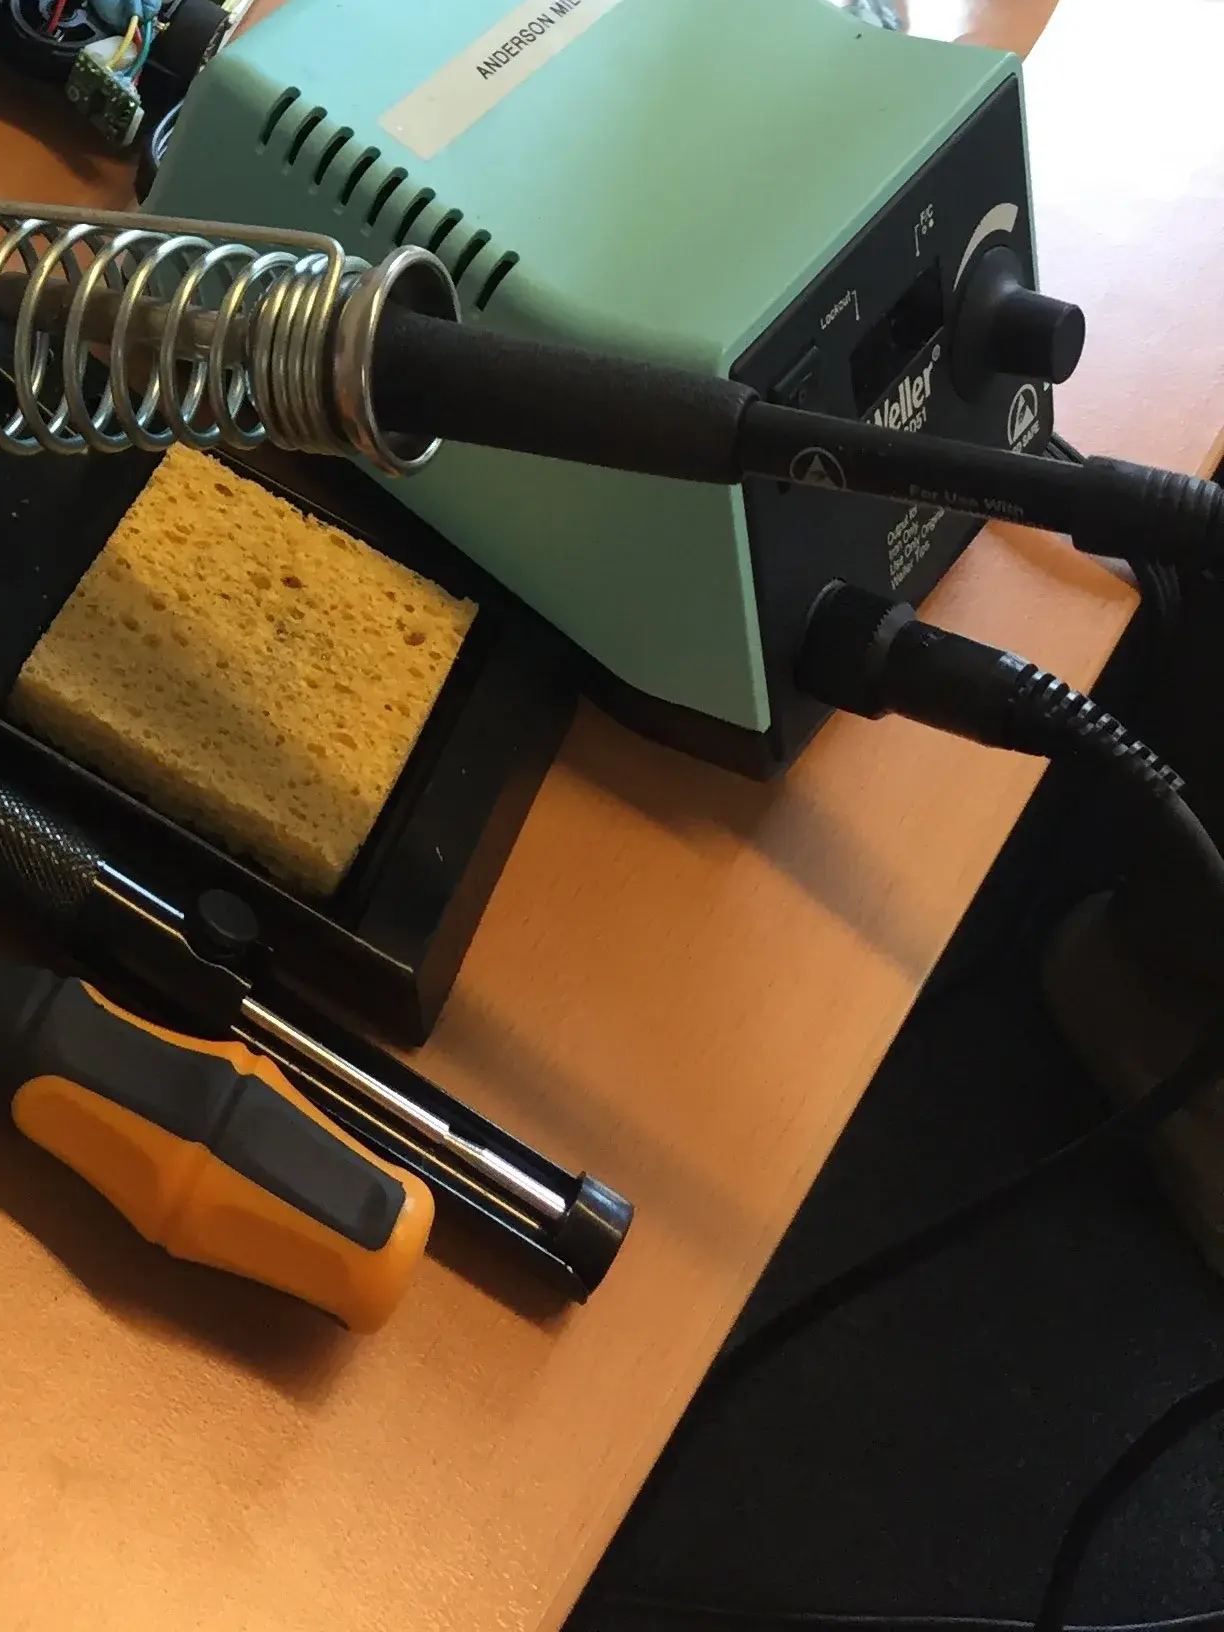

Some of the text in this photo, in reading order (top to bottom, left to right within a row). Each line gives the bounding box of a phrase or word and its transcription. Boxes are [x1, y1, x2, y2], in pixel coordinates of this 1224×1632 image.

[476, 13, 556, 79] ANDERSON
[820, 289, 853, 330] Lockout
[983, 497, 1025, 517] With
